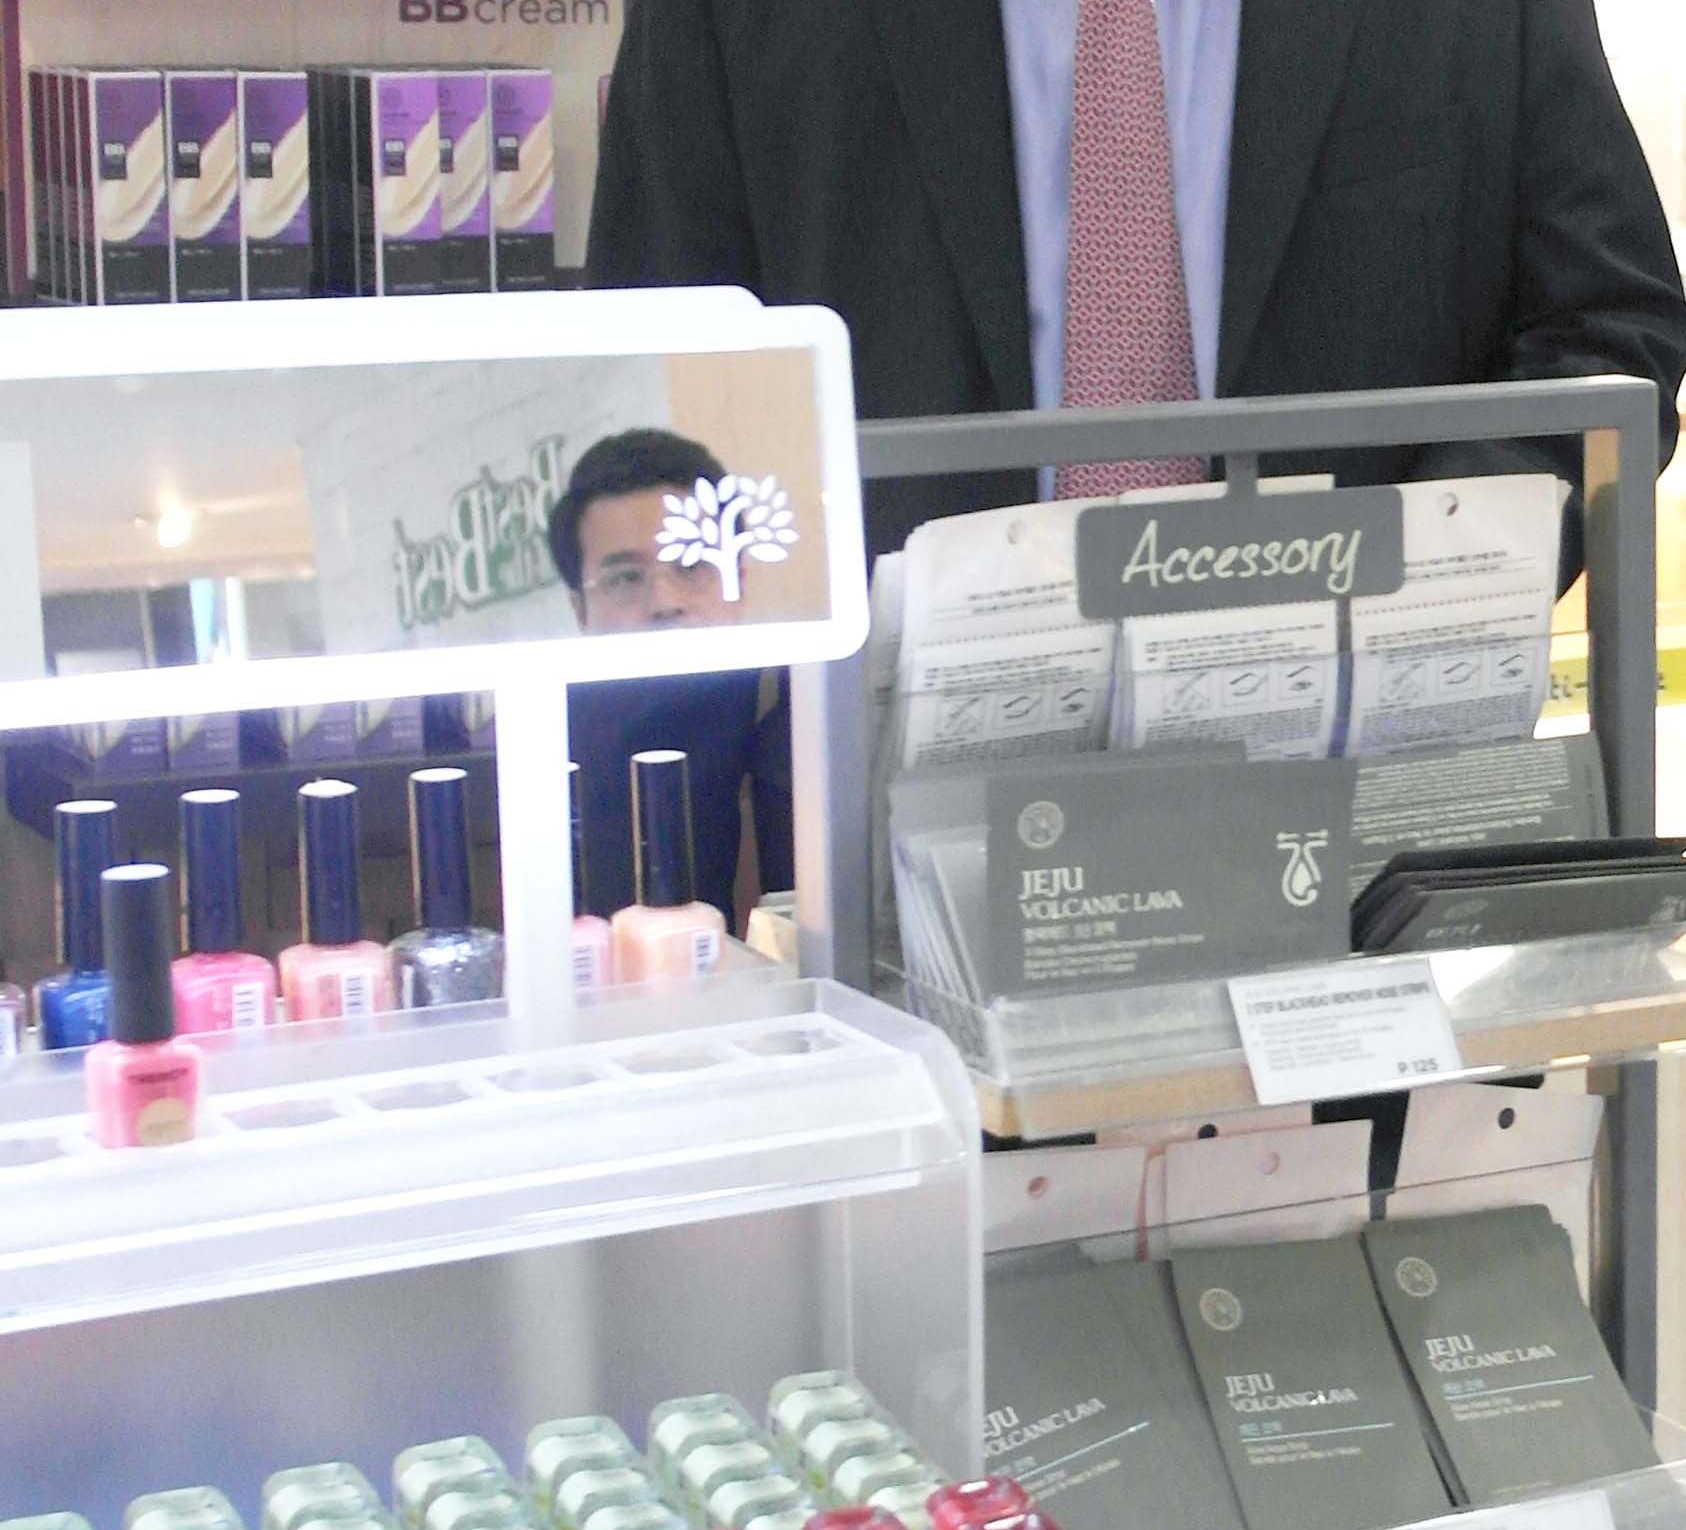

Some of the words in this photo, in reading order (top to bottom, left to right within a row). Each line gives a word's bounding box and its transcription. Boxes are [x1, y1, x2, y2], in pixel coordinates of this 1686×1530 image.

[1121, 518, 1363, 595] Accessory
[1018, 866, 1085, 902] JEJU
[1019, 893, 1131, 920] VOLCANIC
[1133, 889, 1184, 913] LAVA
[1424, 1334, 1475, 1361] JEJU
[1224, 1372, 1276, 1399] JEJU
[984, 1412, 1065, 1459] OLCANIC
